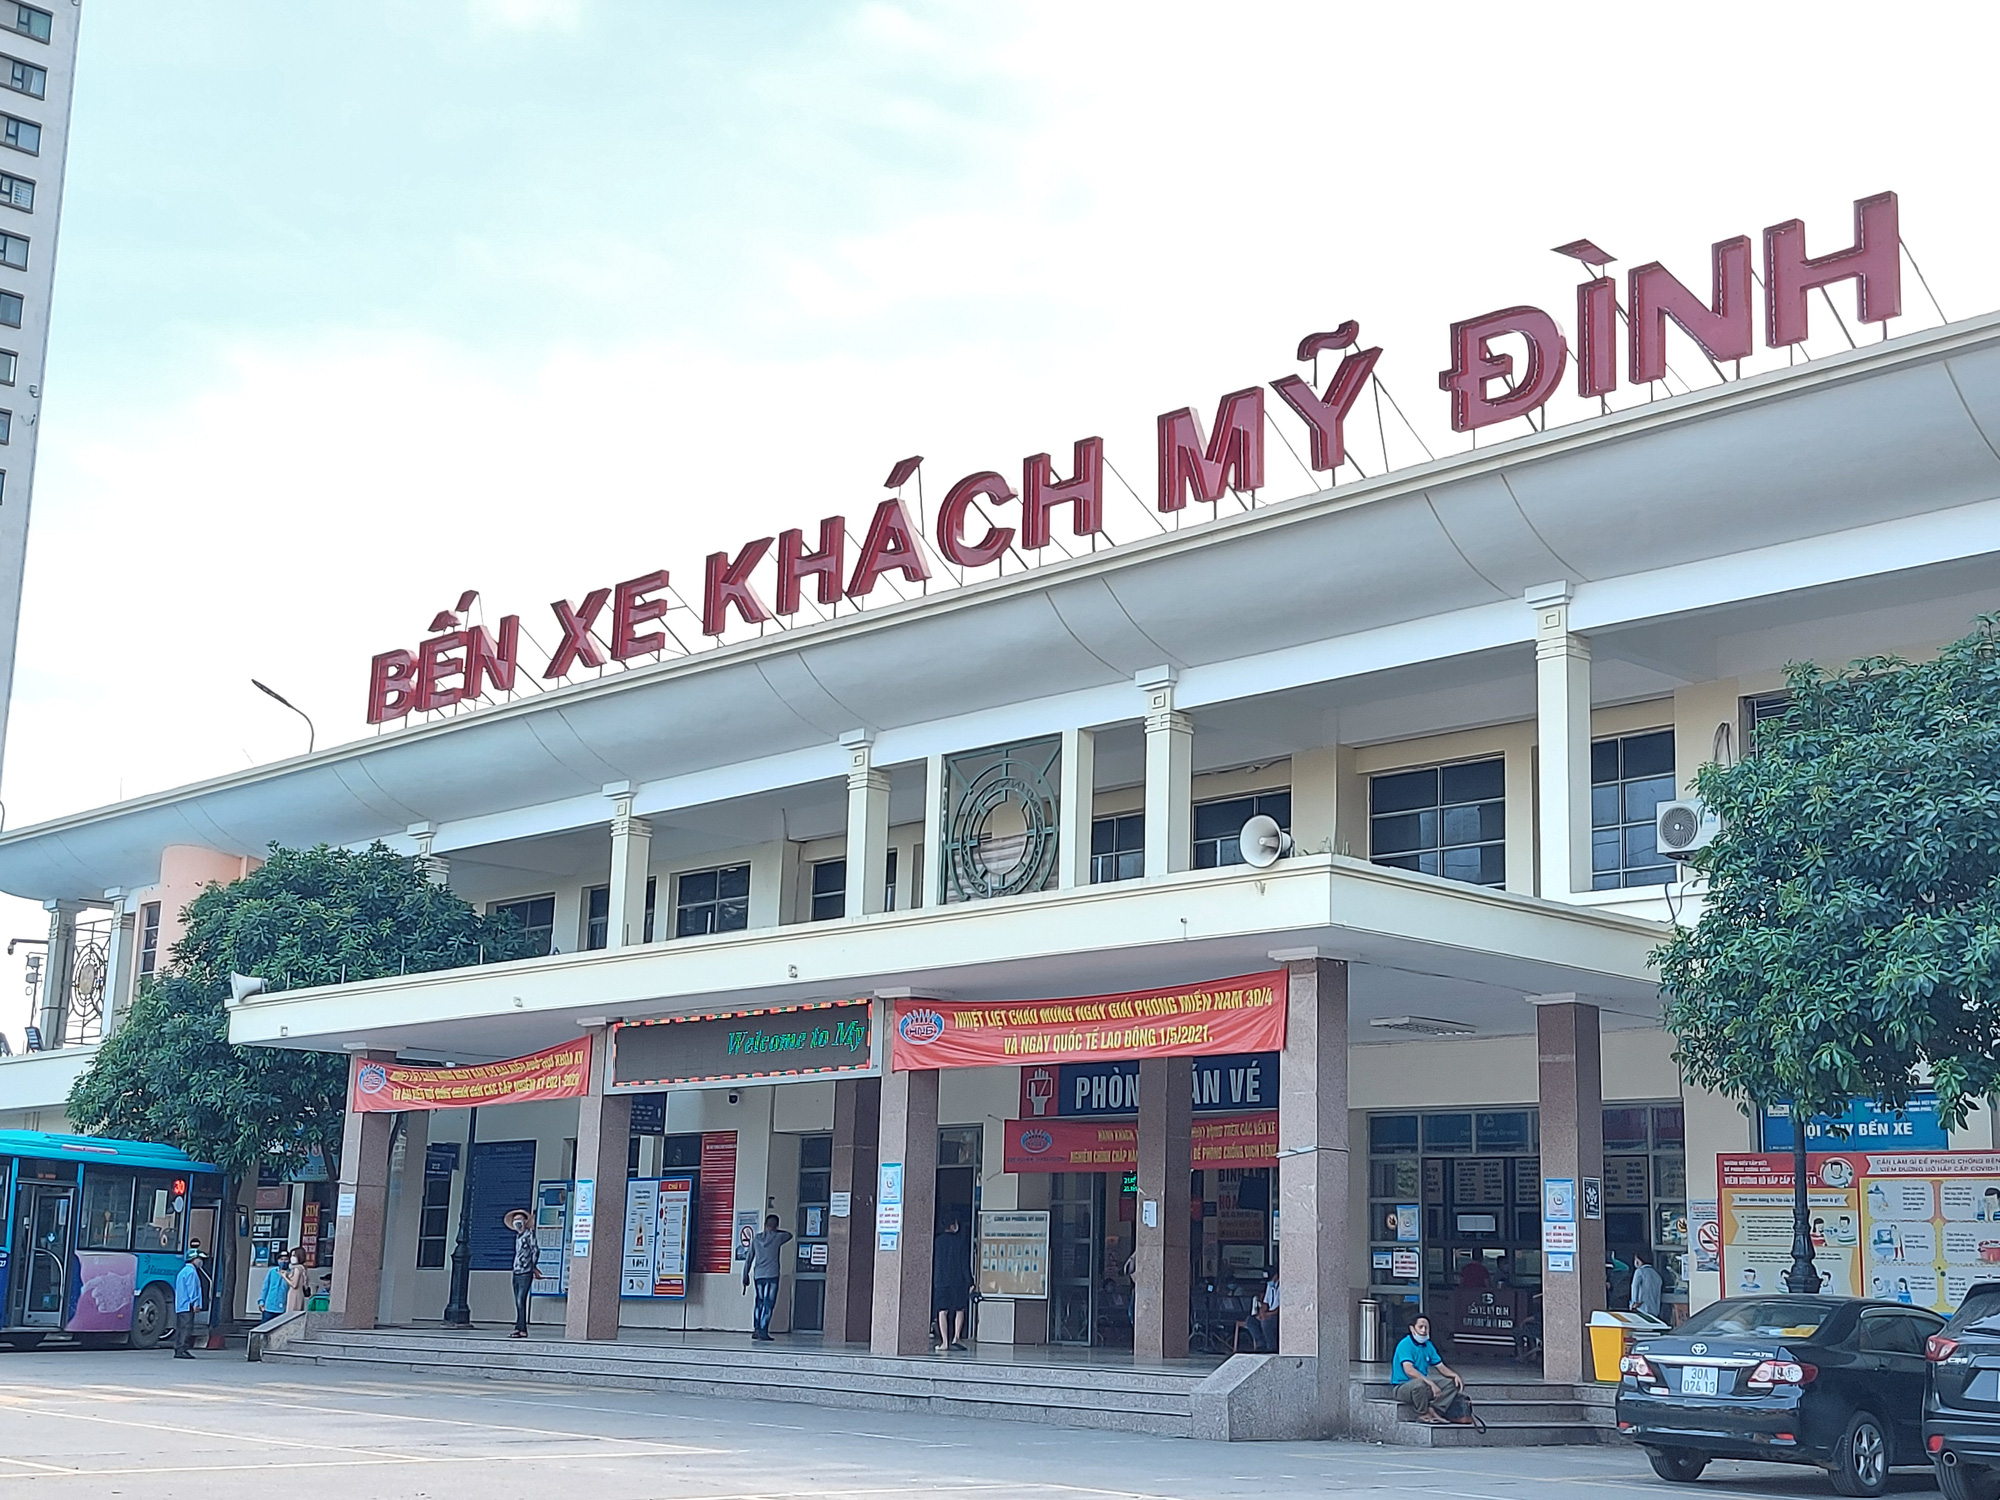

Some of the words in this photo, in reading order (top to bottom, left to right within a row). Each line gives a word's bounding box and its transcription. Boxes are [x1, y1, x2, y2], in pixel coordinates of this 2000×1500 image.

[367, 590, 519, 725] BẾN
[543, 569, 669, 680] XE
[702, 457, 1104, 636] KHÁCH
[1158, 319, 1384, 513] MỸ
[1439, 189, 1902, 434] ĐÌNH
[954, 1008, 983, 1031] NHIỆT
[985, 1010, 1007, 1030] LIỆT
[1213, 990, 1244, 1011] NAM
[1245, 987, 1273, 1007] 30/4
[728, 1030, 806, 1055] Welcome
[810, 1026, 829, 1048] to
[831, 1020, 865, 1052] My
[1004, 1034, 1019, 1054] VÀ
[1020, 1032, 1050, 1054] NGÀY
[1053, 1028, 1083, 1054] QUỐC
[1086, 1026, 1099, 1050] TẾ
[1100, 1030, 1121, 1049] LAO
[1124, 1026, 1157, 1052] ĐỘNG
[1075, 1066, 1139, 1109] PHÒN
[1191, 1060, 1220, 1104] ÁN
[1229, 1060, 1261, 1103] VÉ
[1804, 1122, 1821, 1139] ỘI
[1858, 1119, 1888, 1136] BẾN
[1893, 1122, 1913, 1135] XE
[1691, 1368, 1709, 1380] 30A
